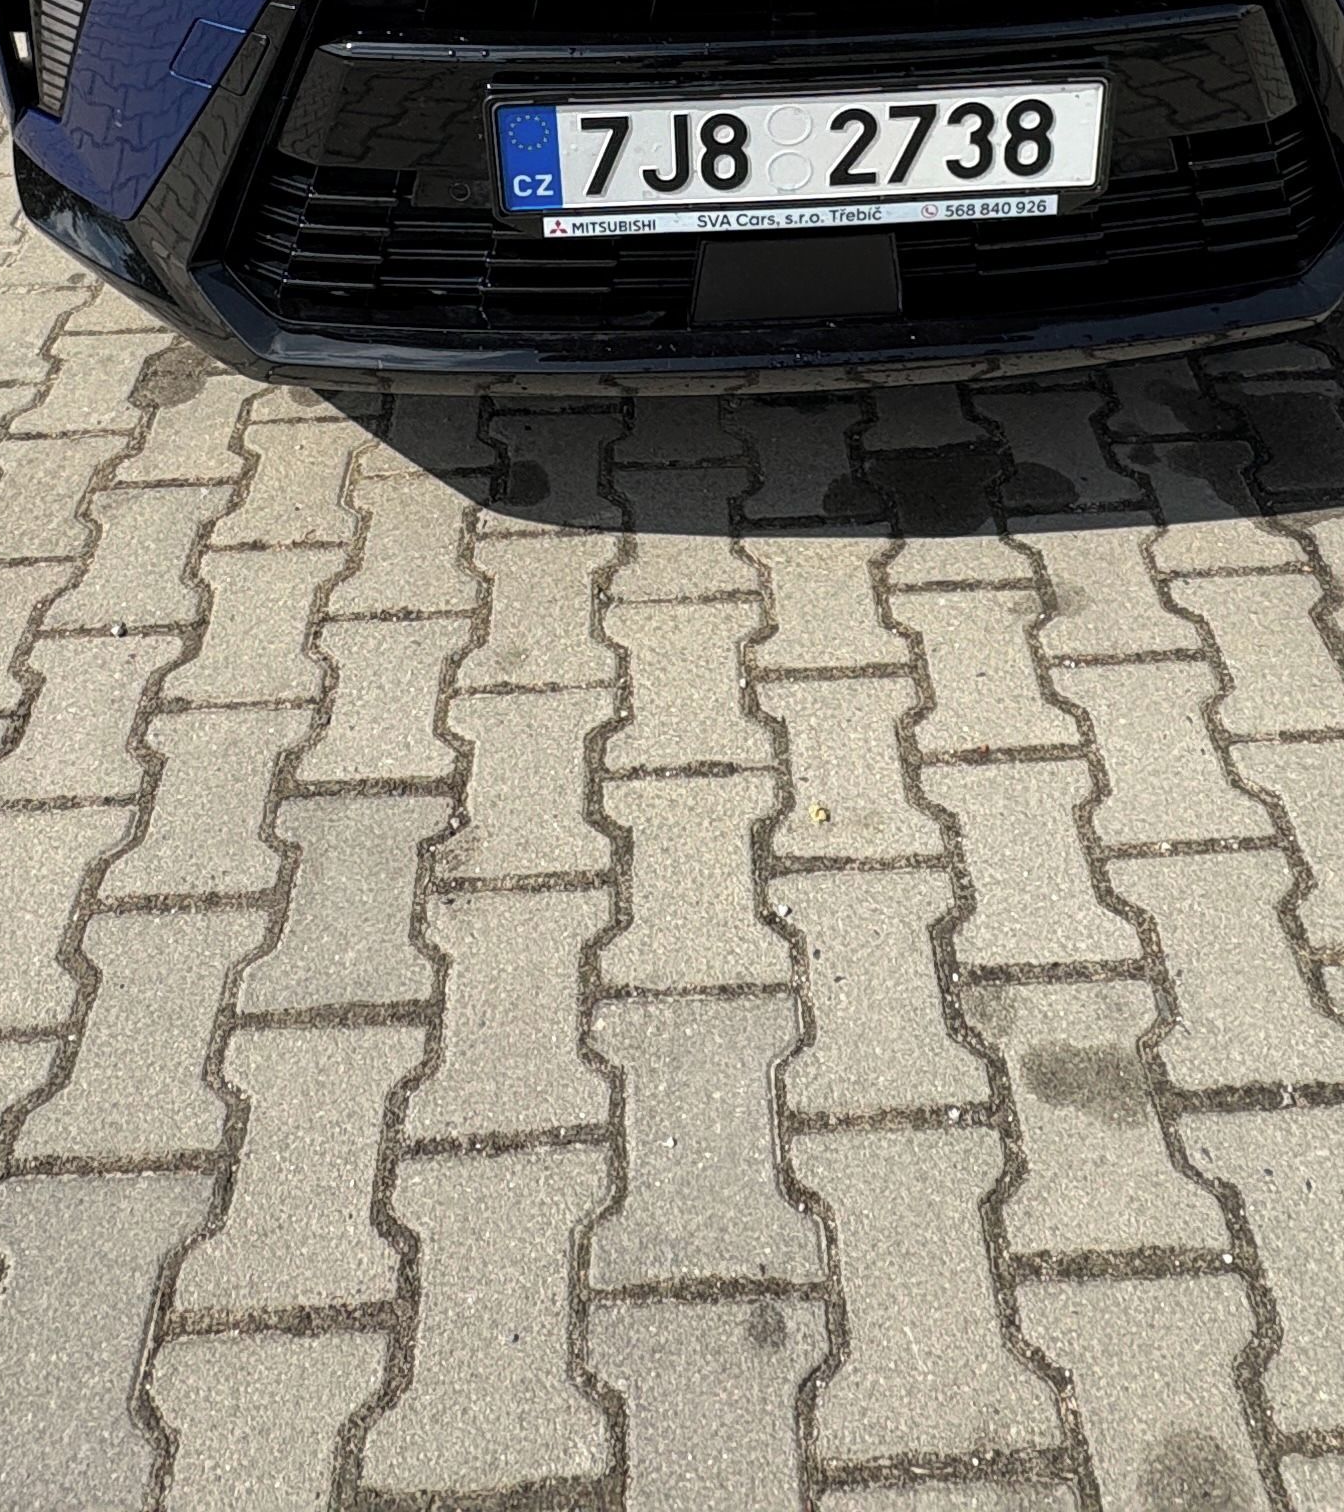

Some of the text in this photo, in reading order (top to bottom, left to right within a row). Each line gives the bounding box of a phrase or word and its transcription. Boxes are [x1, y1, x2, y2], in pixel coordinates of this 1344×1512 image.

[580, 98, 1054, 197] 7J8 2738
[513, 174, 554, 197] CZ
[697, 206, 882, 228] SVA Cars, s.r.o. Třebíč
[945, 200, 1047, 218] 568 840 926
[572, 219, 656, 234] MITSUBISHI
